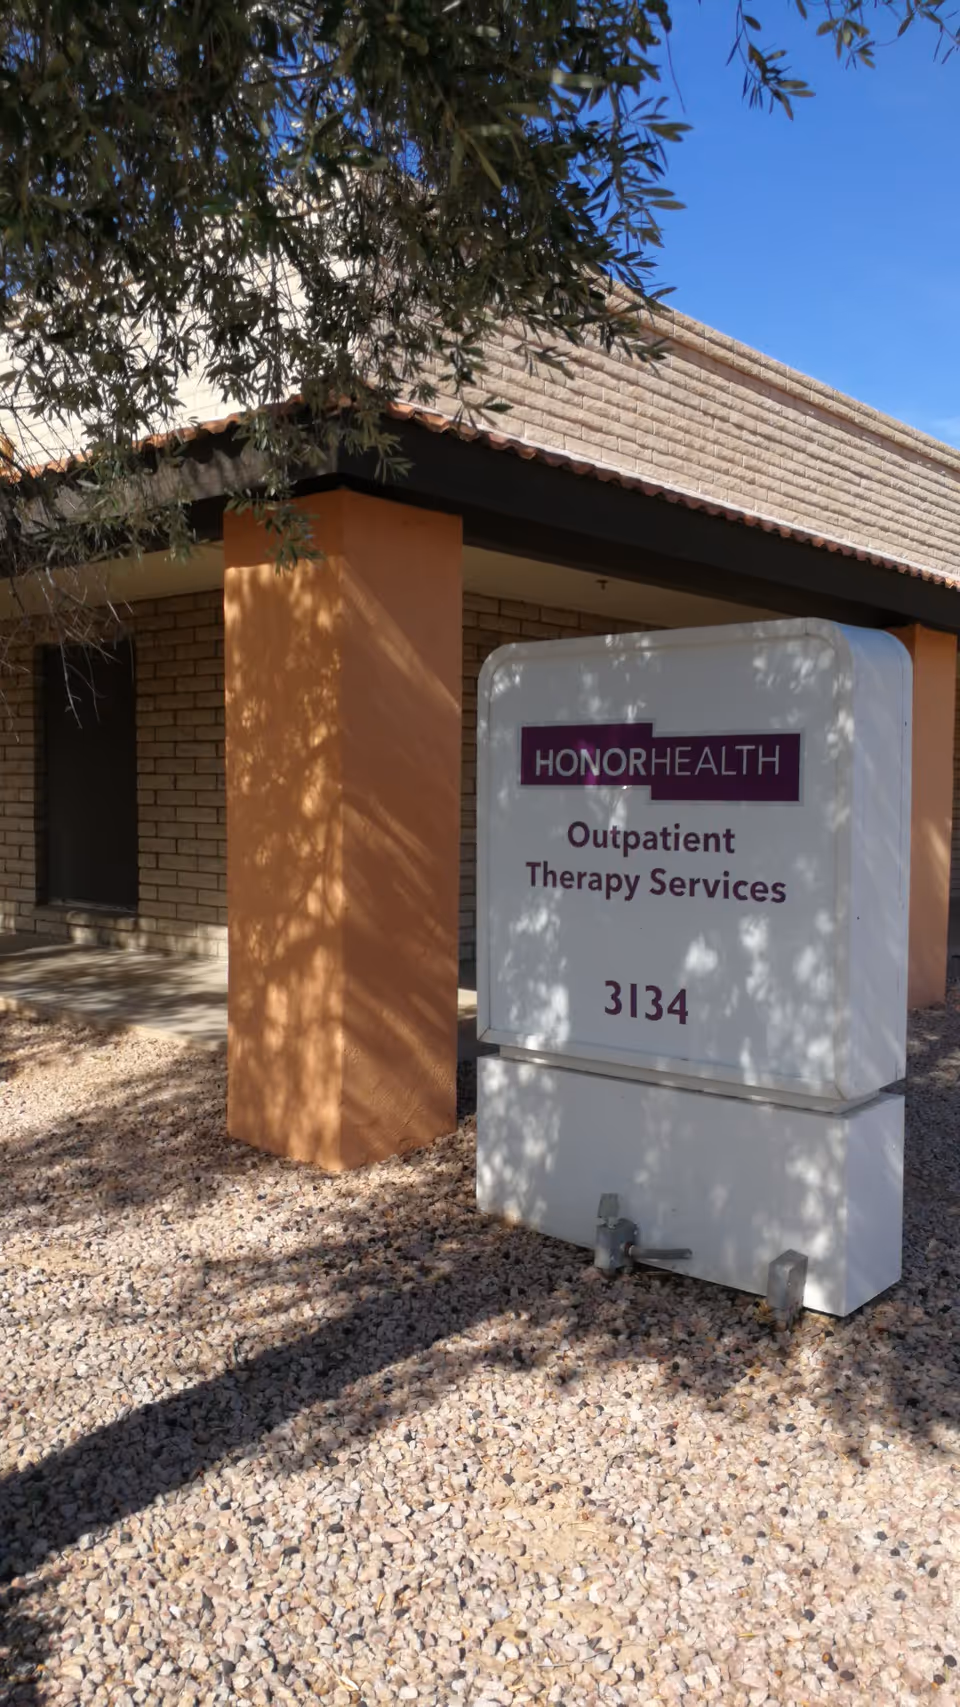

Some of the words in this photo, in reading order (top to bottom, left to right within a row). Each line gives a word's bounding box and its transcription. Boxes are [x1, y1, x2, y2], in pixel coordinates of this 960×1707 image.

[567, 821, 736, 857] Outpatient
[525, 861, 640, 901] Therapy
[649, 867, 787, 904] Services
[604, 980, 689, 1025] 3134
